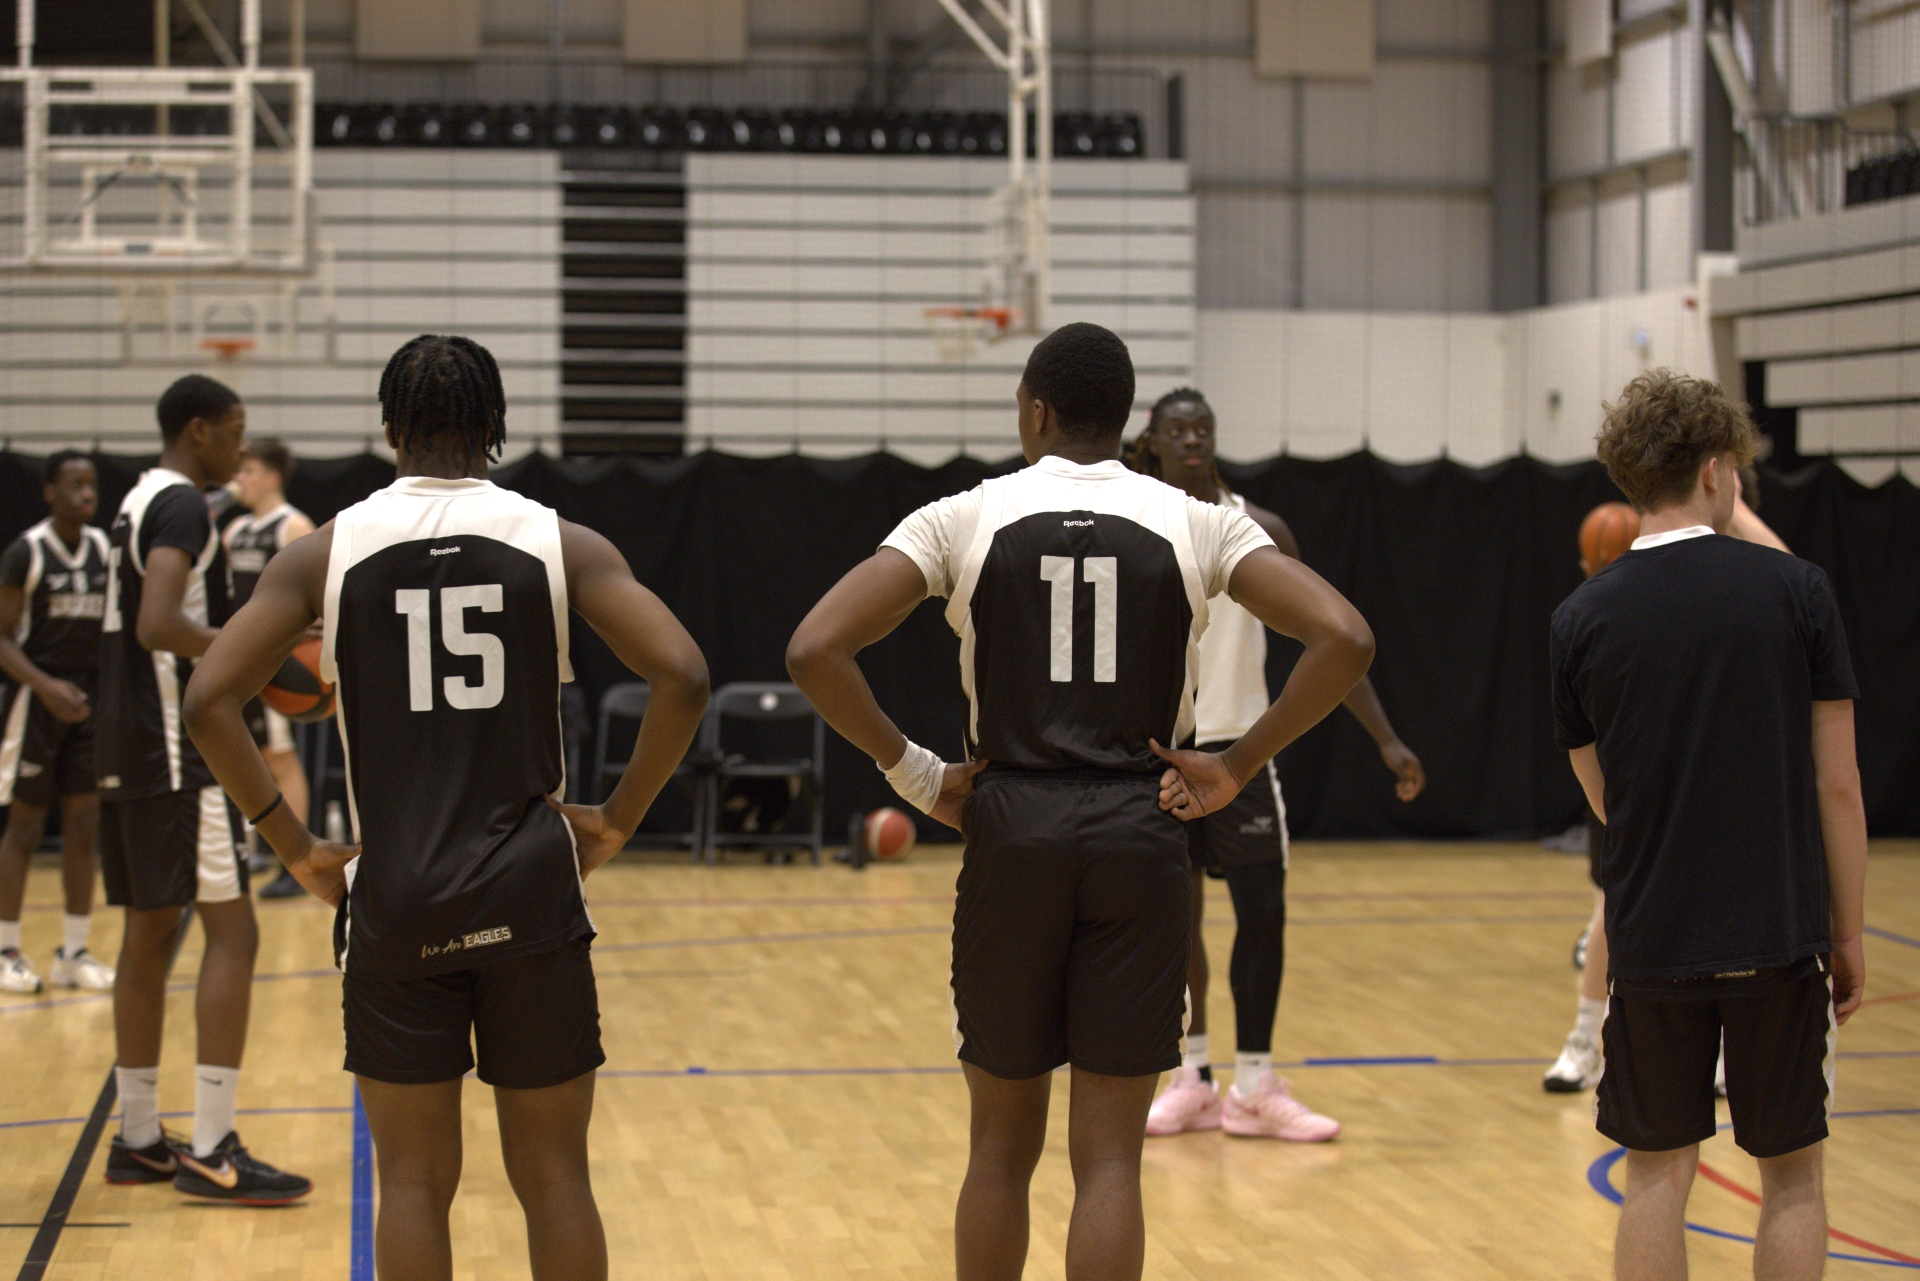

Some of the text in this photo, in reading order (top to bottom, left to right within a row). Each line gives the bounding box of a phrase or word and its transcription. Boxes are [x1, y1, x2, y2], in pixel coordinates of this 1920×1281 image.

[1063, 519, 1095, 528] Reebok
[430, 546, 461, 557] Reebok
[1040, 555, 1117, 682] 11
[396, 584, 504, 711] 15
[421, 926, 512, 958] We Are EAGLES
